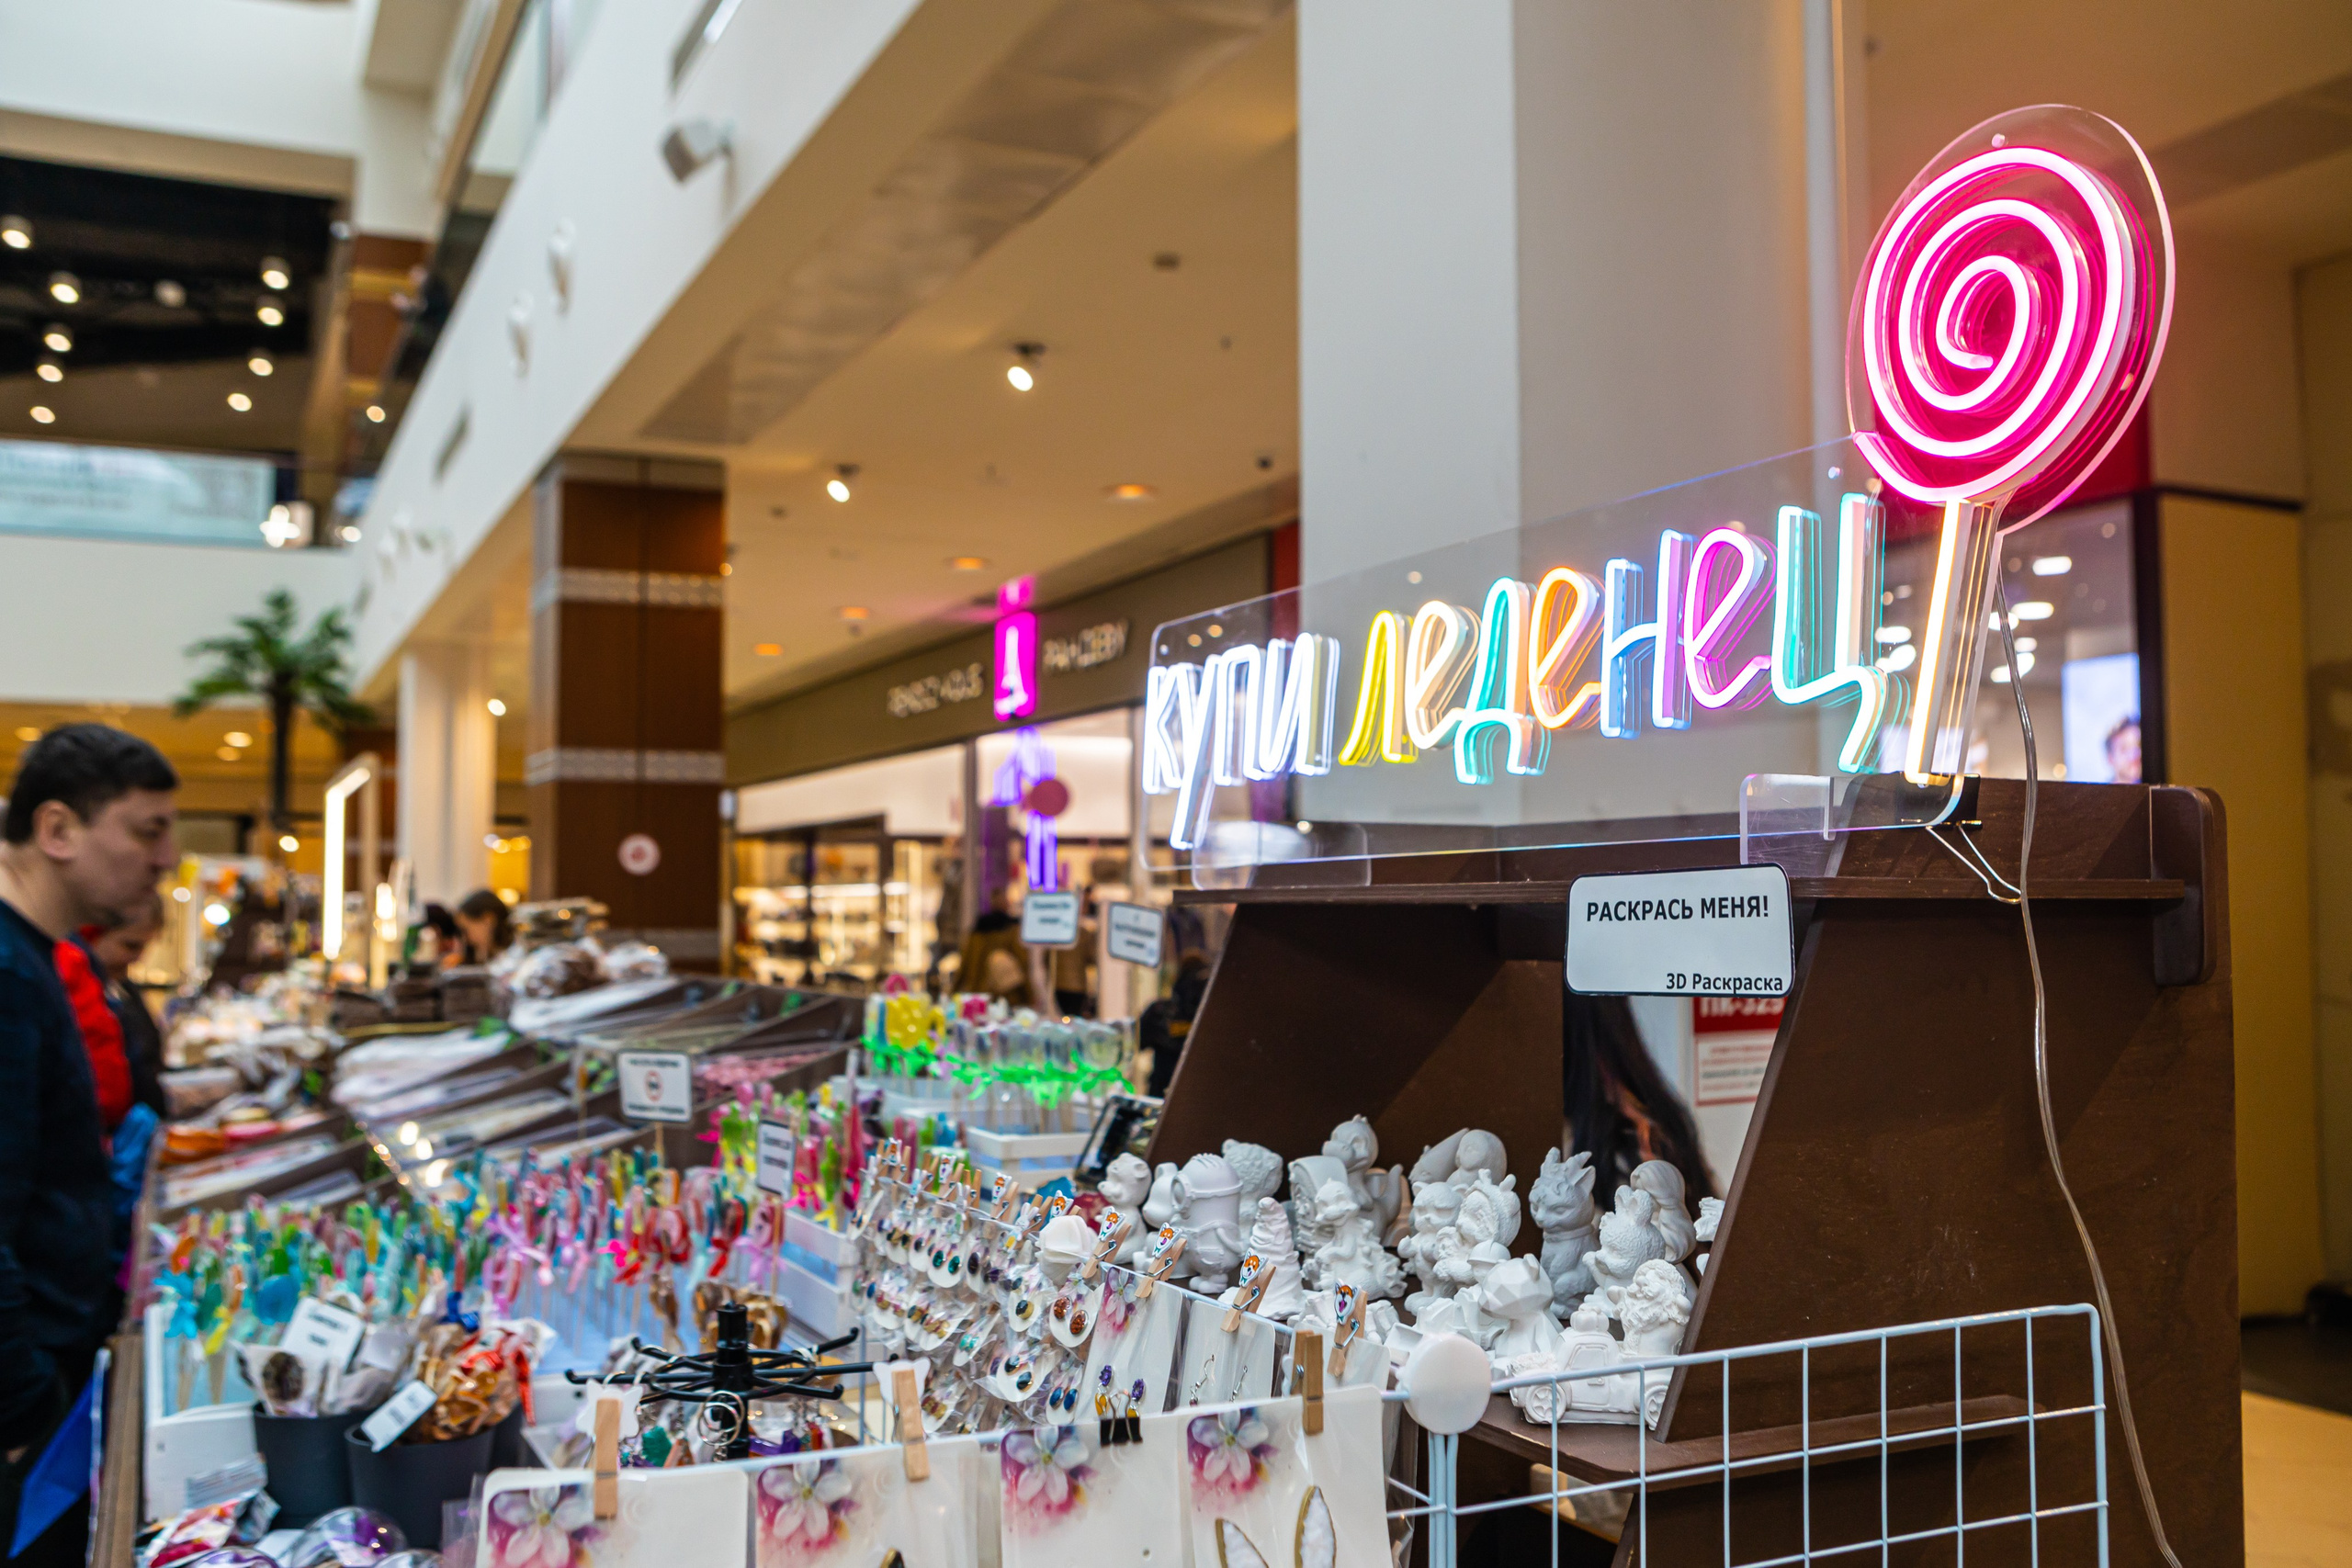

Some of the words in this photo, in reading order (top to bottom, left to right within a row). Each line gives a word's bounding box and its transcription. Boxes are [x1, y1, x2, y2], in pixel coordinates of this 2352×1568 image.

[1587, 899, 1693, 921] РАСКРАСЬ
[1701, 896, 1769, 919] МЕНЯ!
[1666, 973, 1687, 989] 3D
[1692, 974, 1783, 994] Раскраска
